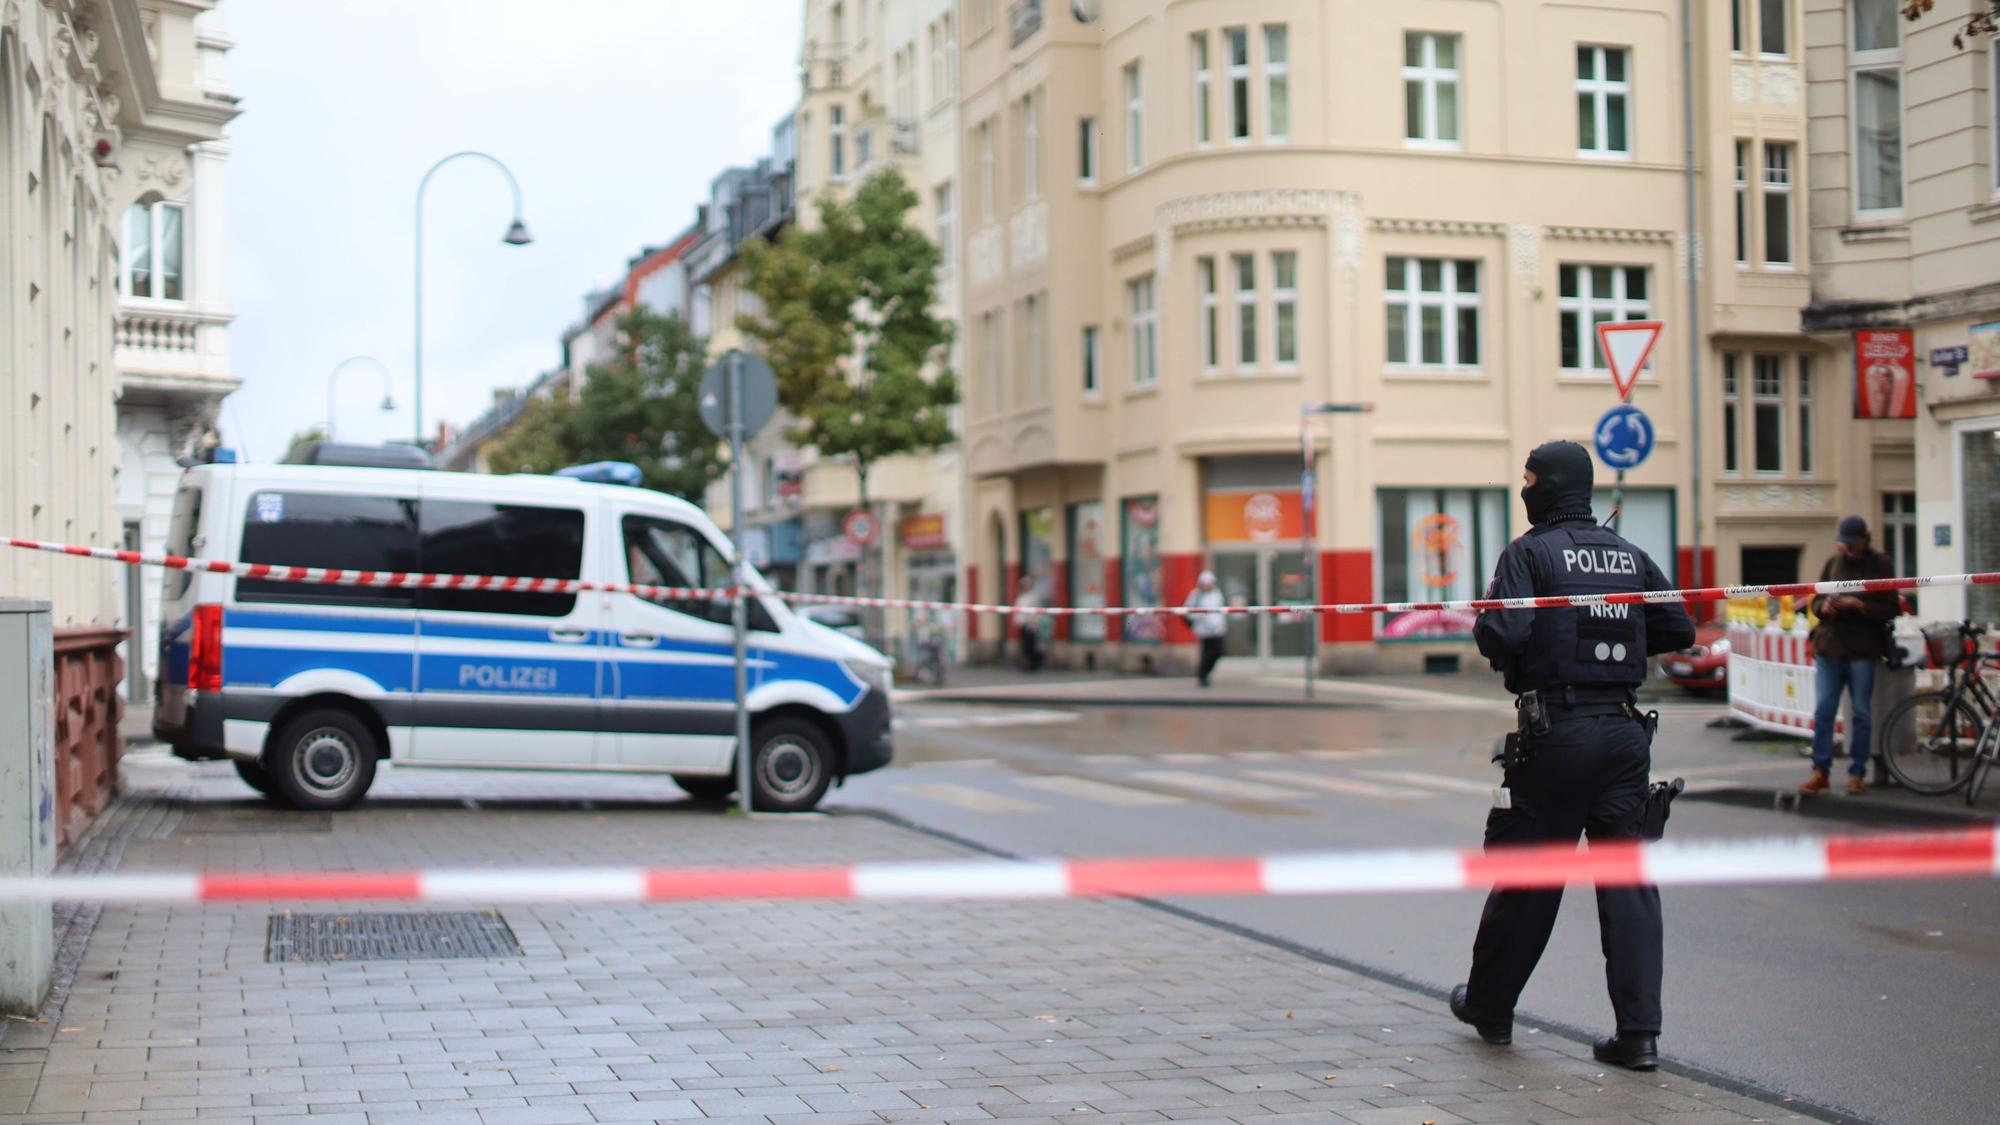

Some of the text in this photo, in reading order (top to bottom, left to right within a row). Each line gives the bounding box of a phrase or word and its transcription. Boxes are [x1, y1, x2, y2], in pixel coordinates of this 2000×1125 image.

[1563, 549, 1637, 575] POLIZEI
[1590, 603, 1629, 620] NRW
[459, 664, 558, 690] POLIZEI
